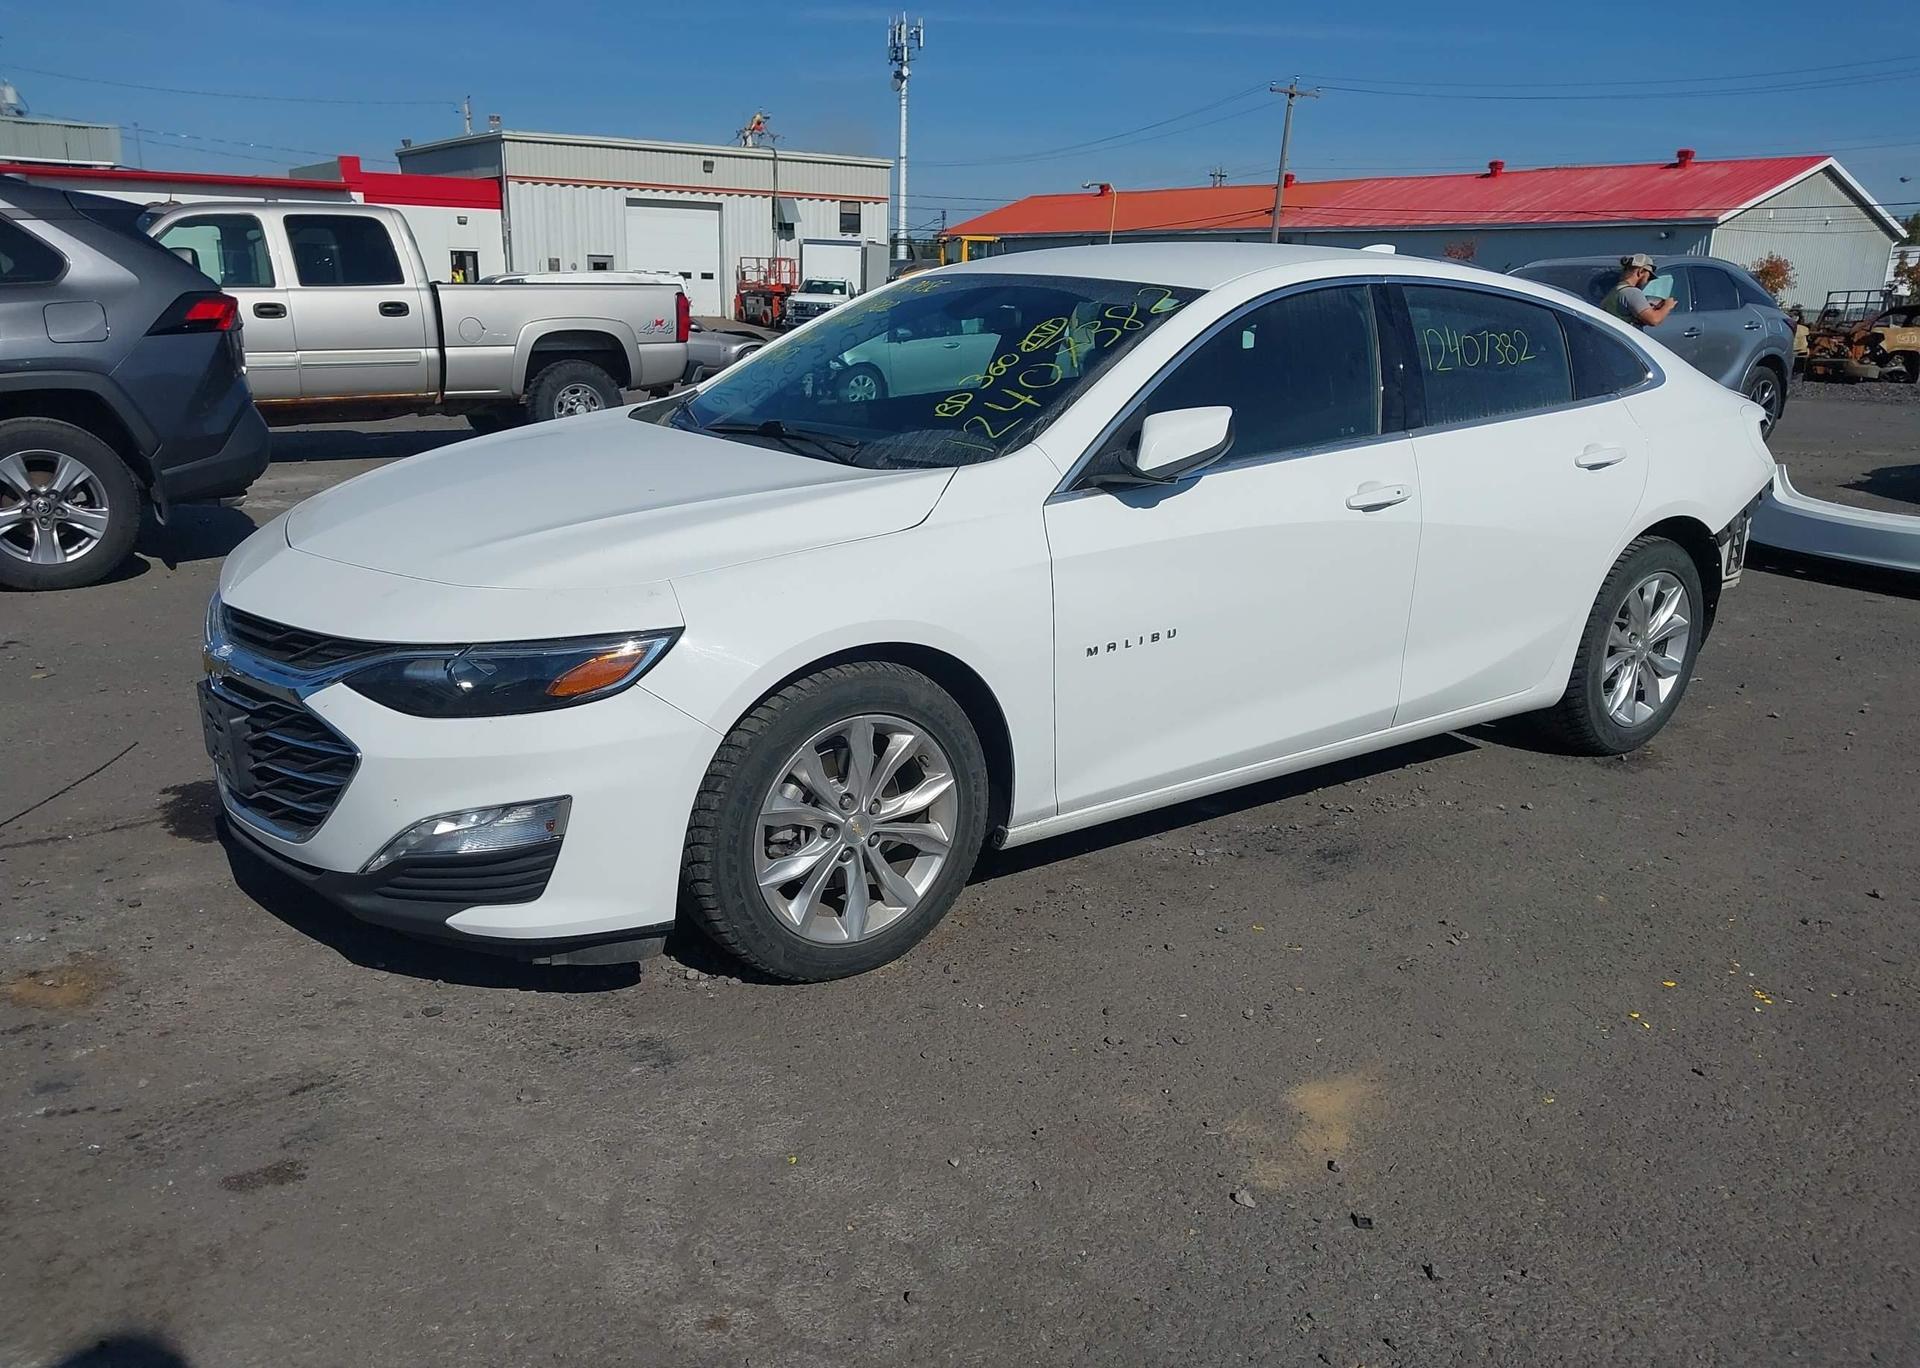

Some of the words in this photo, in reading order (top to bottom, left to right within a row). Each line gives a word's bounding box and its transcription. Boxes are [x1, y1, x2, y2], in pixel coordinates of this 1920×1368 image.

[1422, 325, 1537, 372] 12407382
[959, 353, 1020, 389] 360
[1086, 628, 1177, 658] MALIBU
